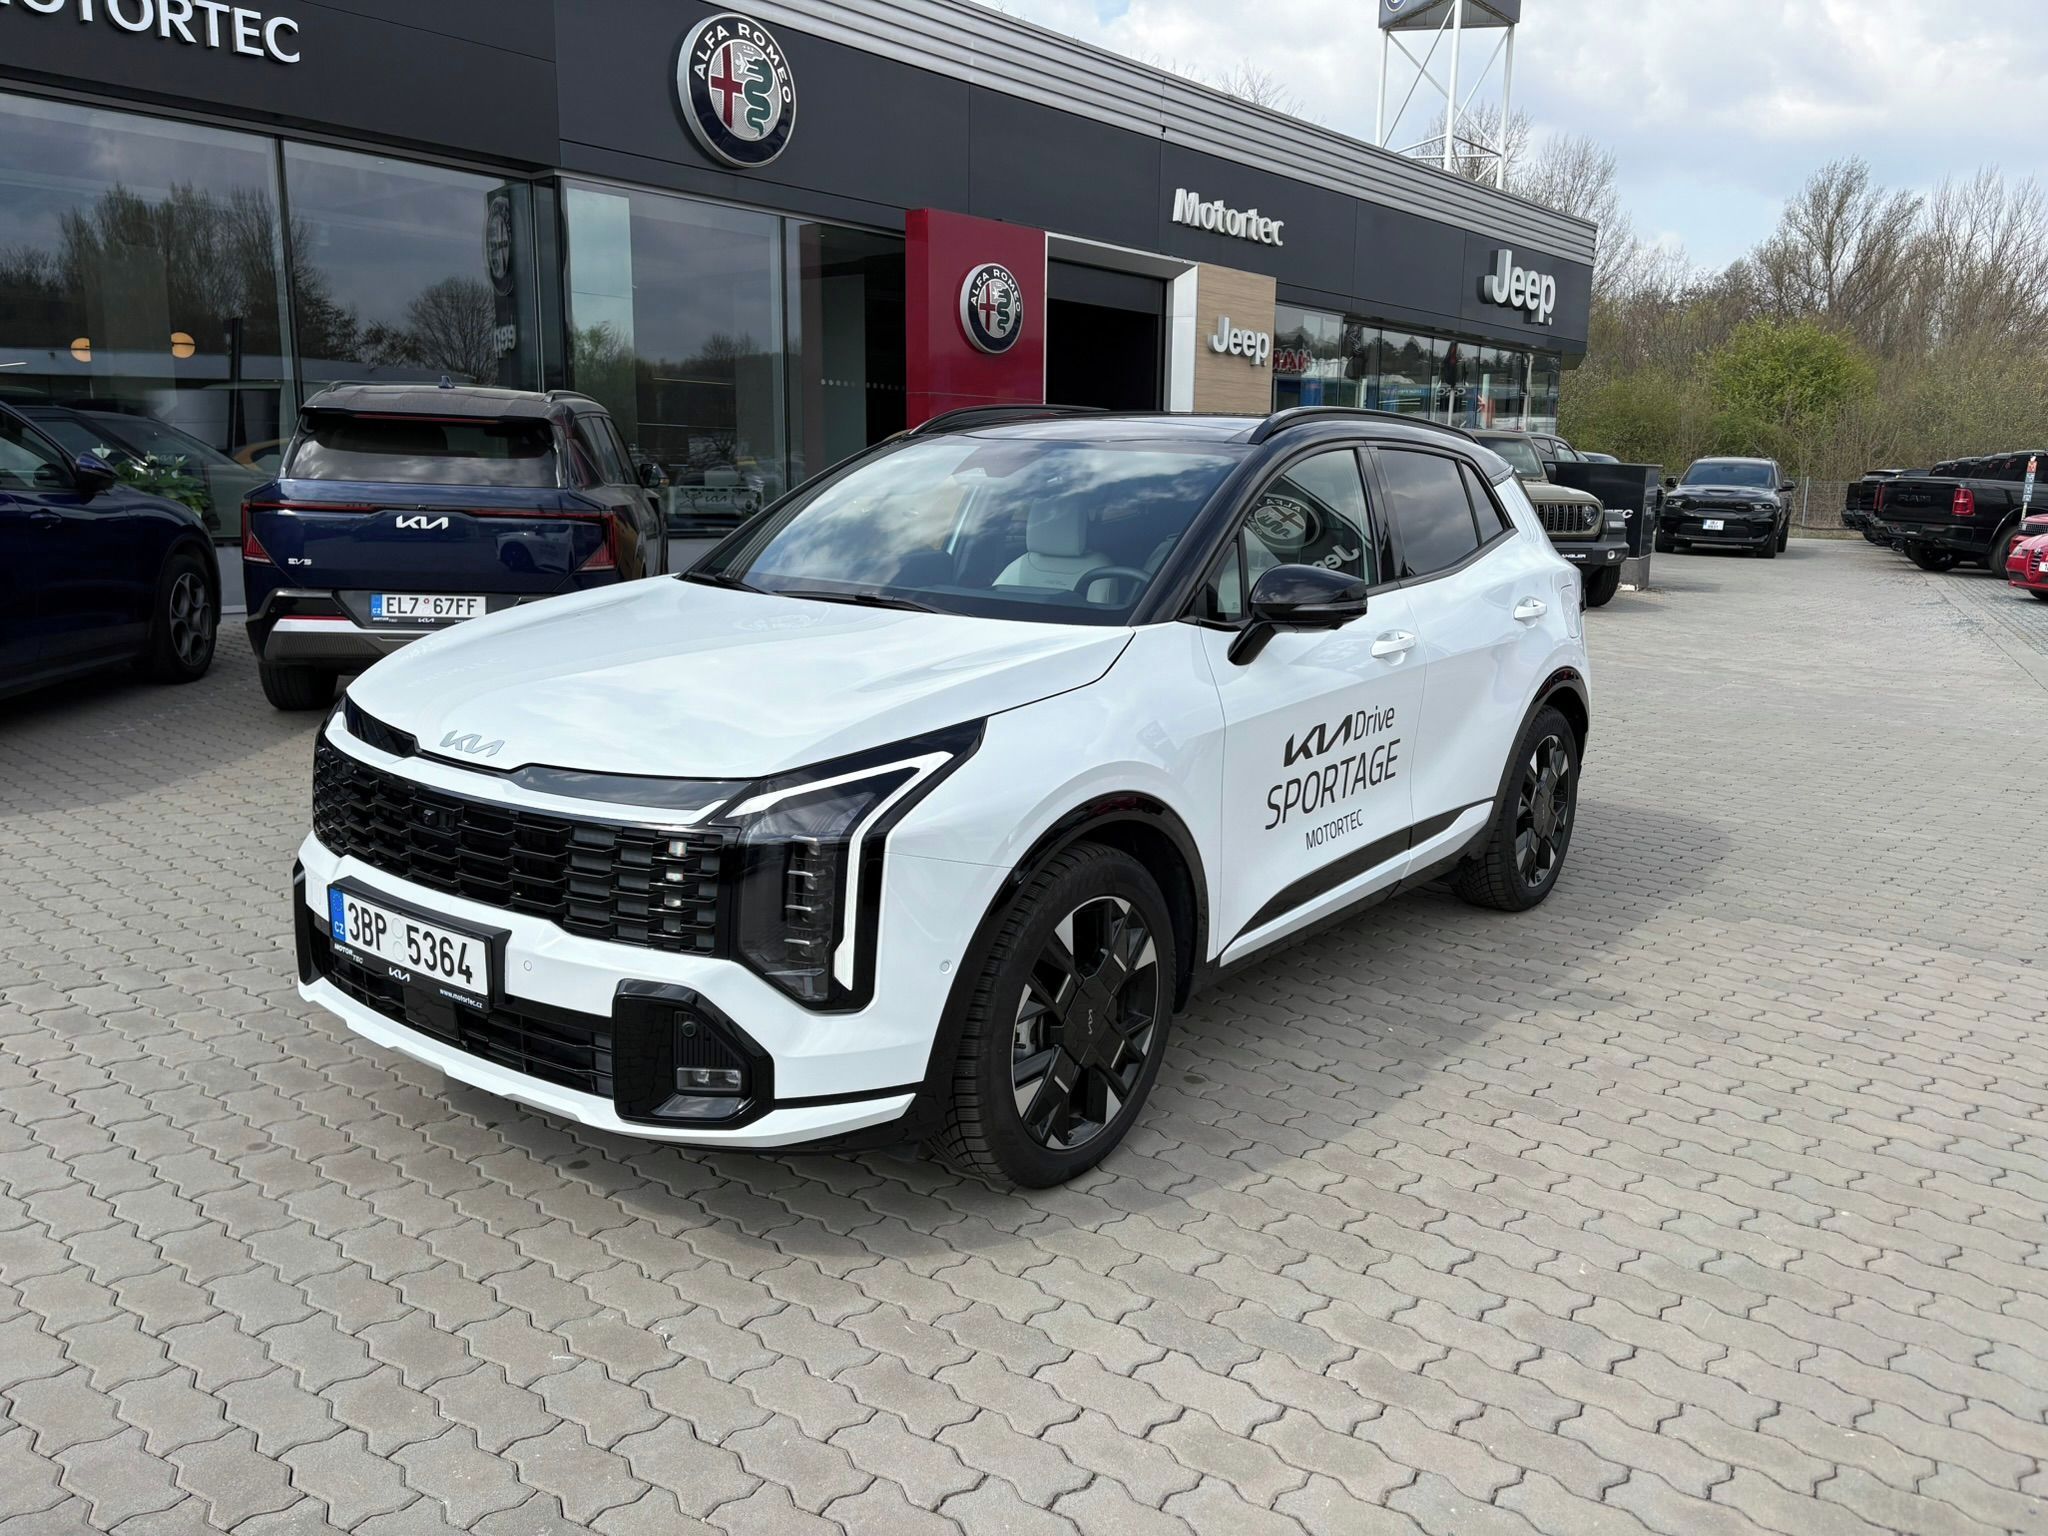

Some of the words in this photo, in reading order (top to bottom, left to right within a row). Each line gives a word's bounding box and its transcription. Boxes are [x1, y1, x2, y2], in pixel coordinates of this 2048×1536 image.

[694, 25, 730, 80] ALFA
[737, 23, 791, 103] ROMEO
[1173, 188, 1284, 246] Motortec
[970, 272, 989, 306] ALFA
[993, 269, 1021, 312] ROMEO
[1486, 249, 1556, 325] Jeep
[1210, 315, 1270, 366] Jeep
[396, 515, 449, 530] KIA
[386, 597, 419, 615] EL7
[433, 598, 477, 615] 67FF
[440, 730, 505, 757] KIA
[1283, 713, 1353, 768] KIA
[1353, 705, 1395, 741] Drive
[1265, 738, 1401, 830] SPORTAGE
[1305, 809, 1364, 850] MOTORTEC
[334, 921, 345, 935] CZ
[348, 902, 387, 951] 3BP
[406, 924, 473, 985] 5364
[333, 943, 354, 957] MOTOR
[352, 954, 364, 965] TEC
[388, 967, 411, 983] KIA
[439, 988, 483, 1009] www.motortec.cz
